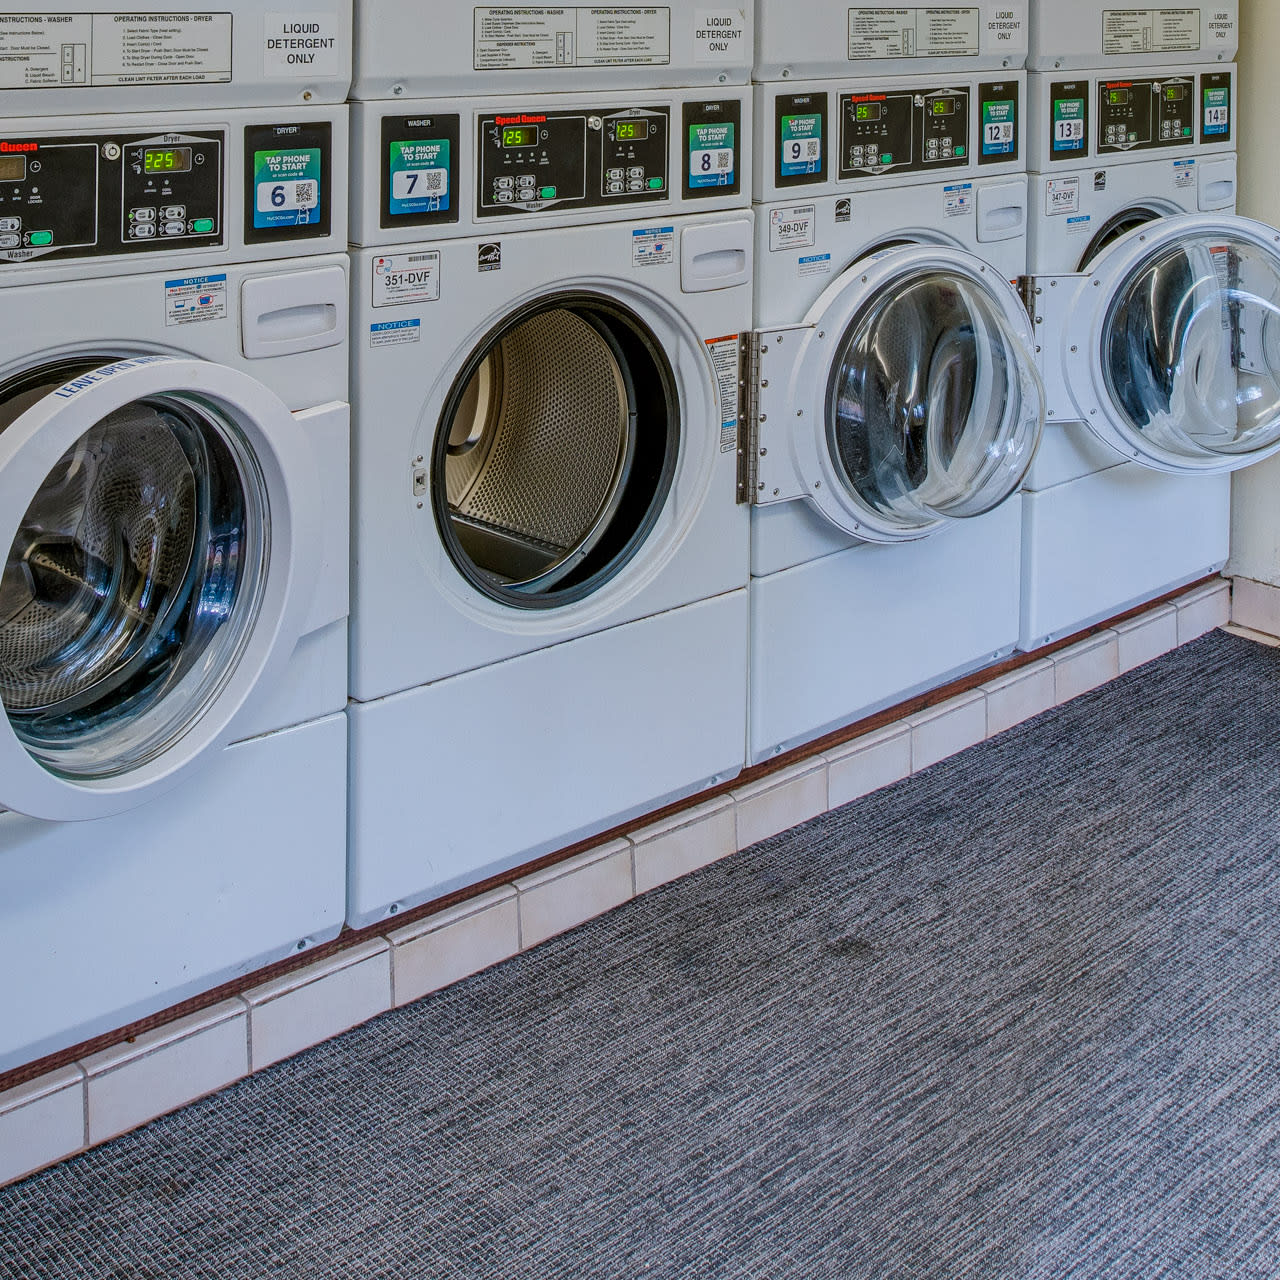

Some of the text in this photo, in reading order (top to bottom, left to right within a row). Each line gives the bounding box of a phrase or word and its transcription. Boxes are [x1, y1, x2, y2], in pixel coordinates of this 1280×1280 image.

[707, 18, 731, 26] LIQUID
[284, 24, 319, 33] LIQUID
[268, 38, 334, 48] DETERGENT
[709, 43, 728, 51] ONLY
[287, 54, 315, 64] ONLY
[496, 115, 546, 125] Speed Queen
[1209, 109, 1219, 123] 14
[989, 126, 1000, 141] 12
[1059, 123, 1072, 138] 13
[163, 135, 180, 143] Dryer
[0, 142, 38, 153] Queen
[400, 146, 414, 154] TAP
[792, 143, 800, 159] 9
[415, 152, 437, 160] START
[282, 162, 307, 170] START
[701, 153, 711, 171] 8
[406, 174, 418, 194] 7
[271, 185, 285, 207] 6
[779, 222, 808, 234] 349-DVF
[7, 251, 34, 259] Washer
[385, 271, 430, 286] 351-DVF
[378, 320, 414, 331] NOTICE
[55, 363, 134, 398] LEAVE OPEN
